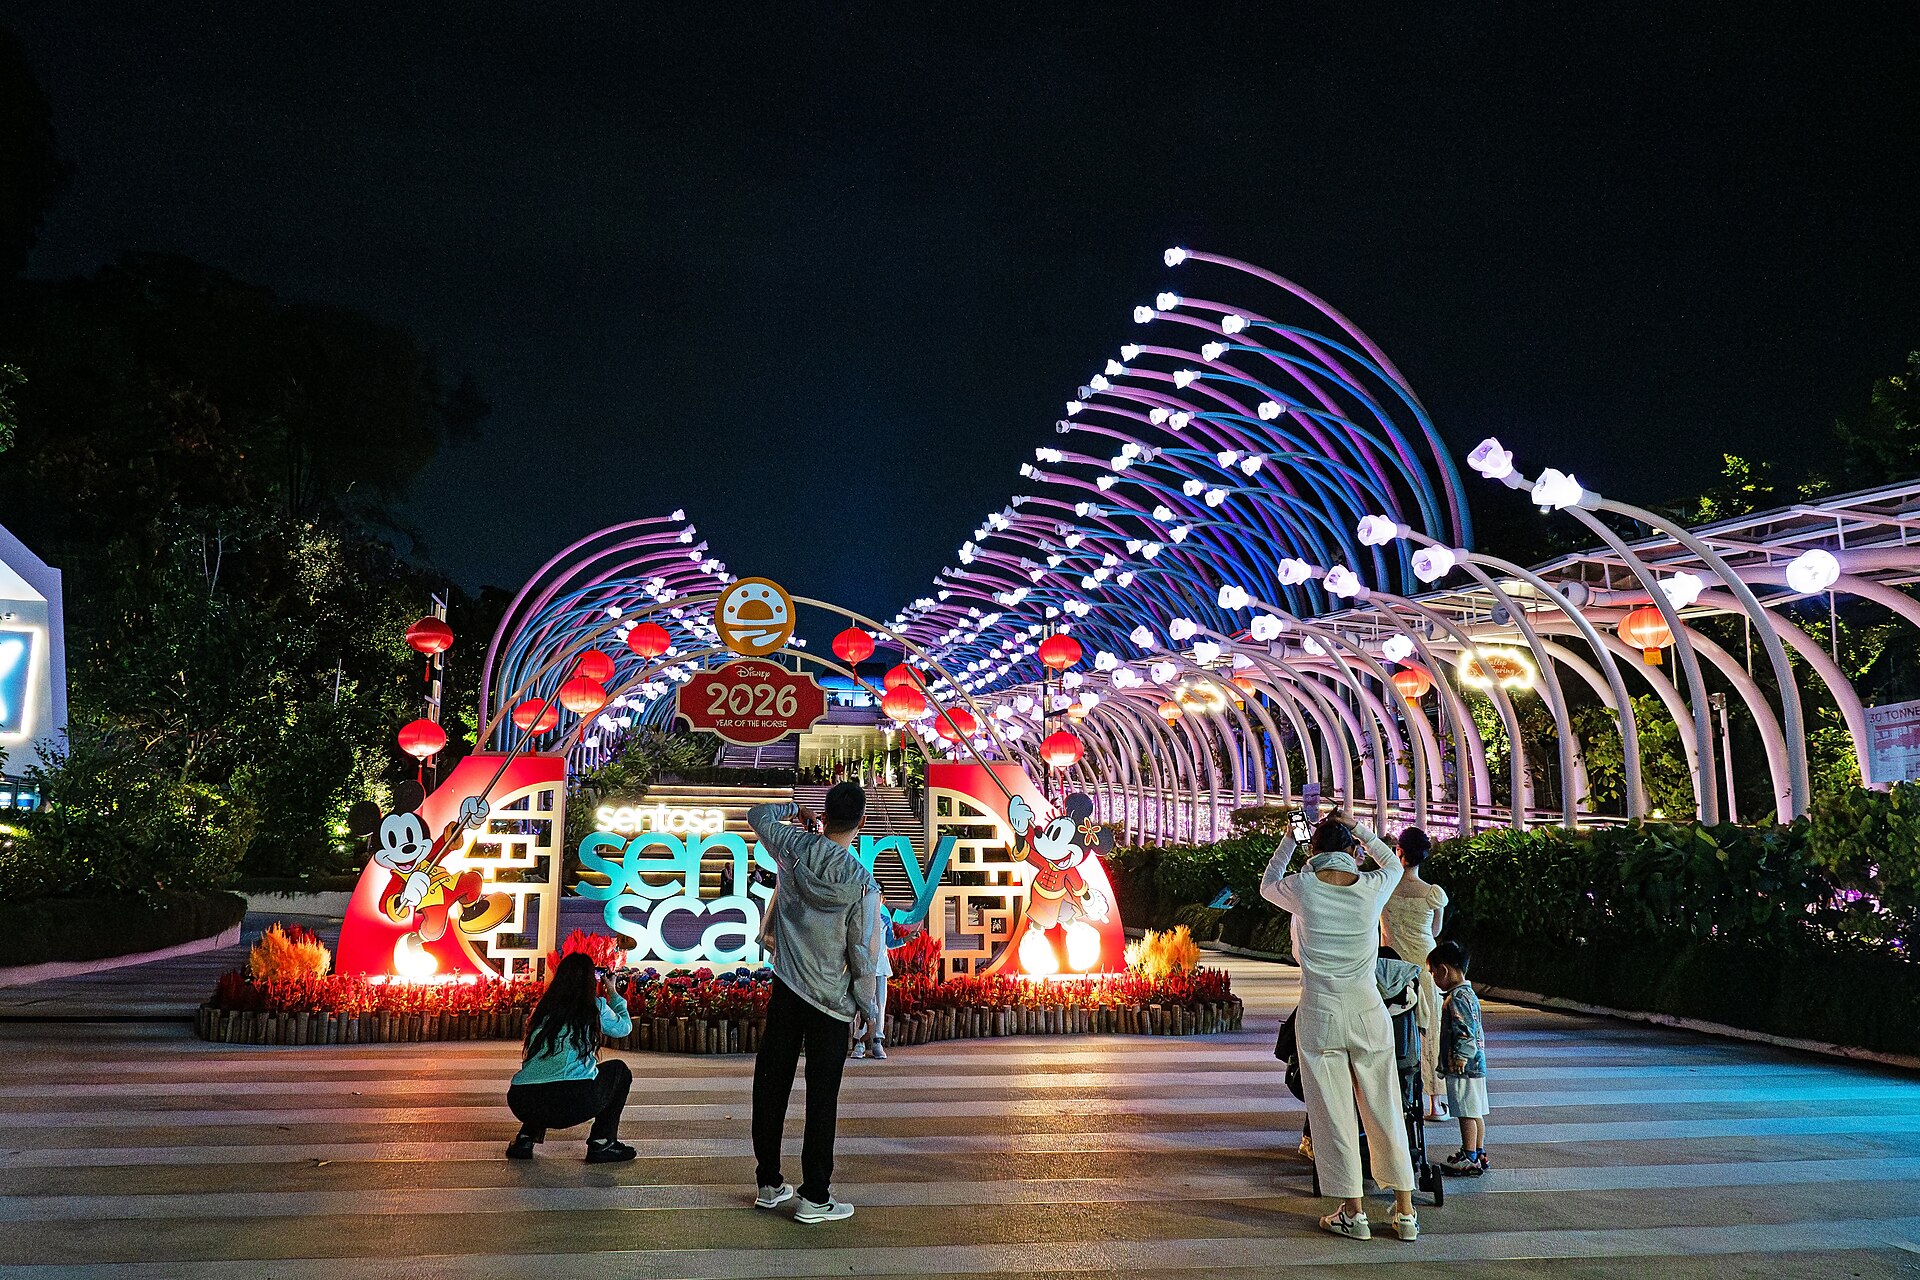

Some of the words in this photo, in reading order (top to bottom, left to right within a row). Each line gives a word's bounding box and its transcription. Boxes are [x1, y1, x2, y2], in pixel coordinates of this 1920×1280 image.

[735, 665, 771, 681] Disney
[706, 682, 798, 717] 2026
[715, 719, 734, 727] YEAR
[734, 719, 746, 727] OF
[747, 719, 760, 727] THE
[761, 719, 788, 728] HORSE
[596, 803, 725, 833] sentosa
[574, 832, 958, 925] sensry
[603, 893, 776, 970] sca
